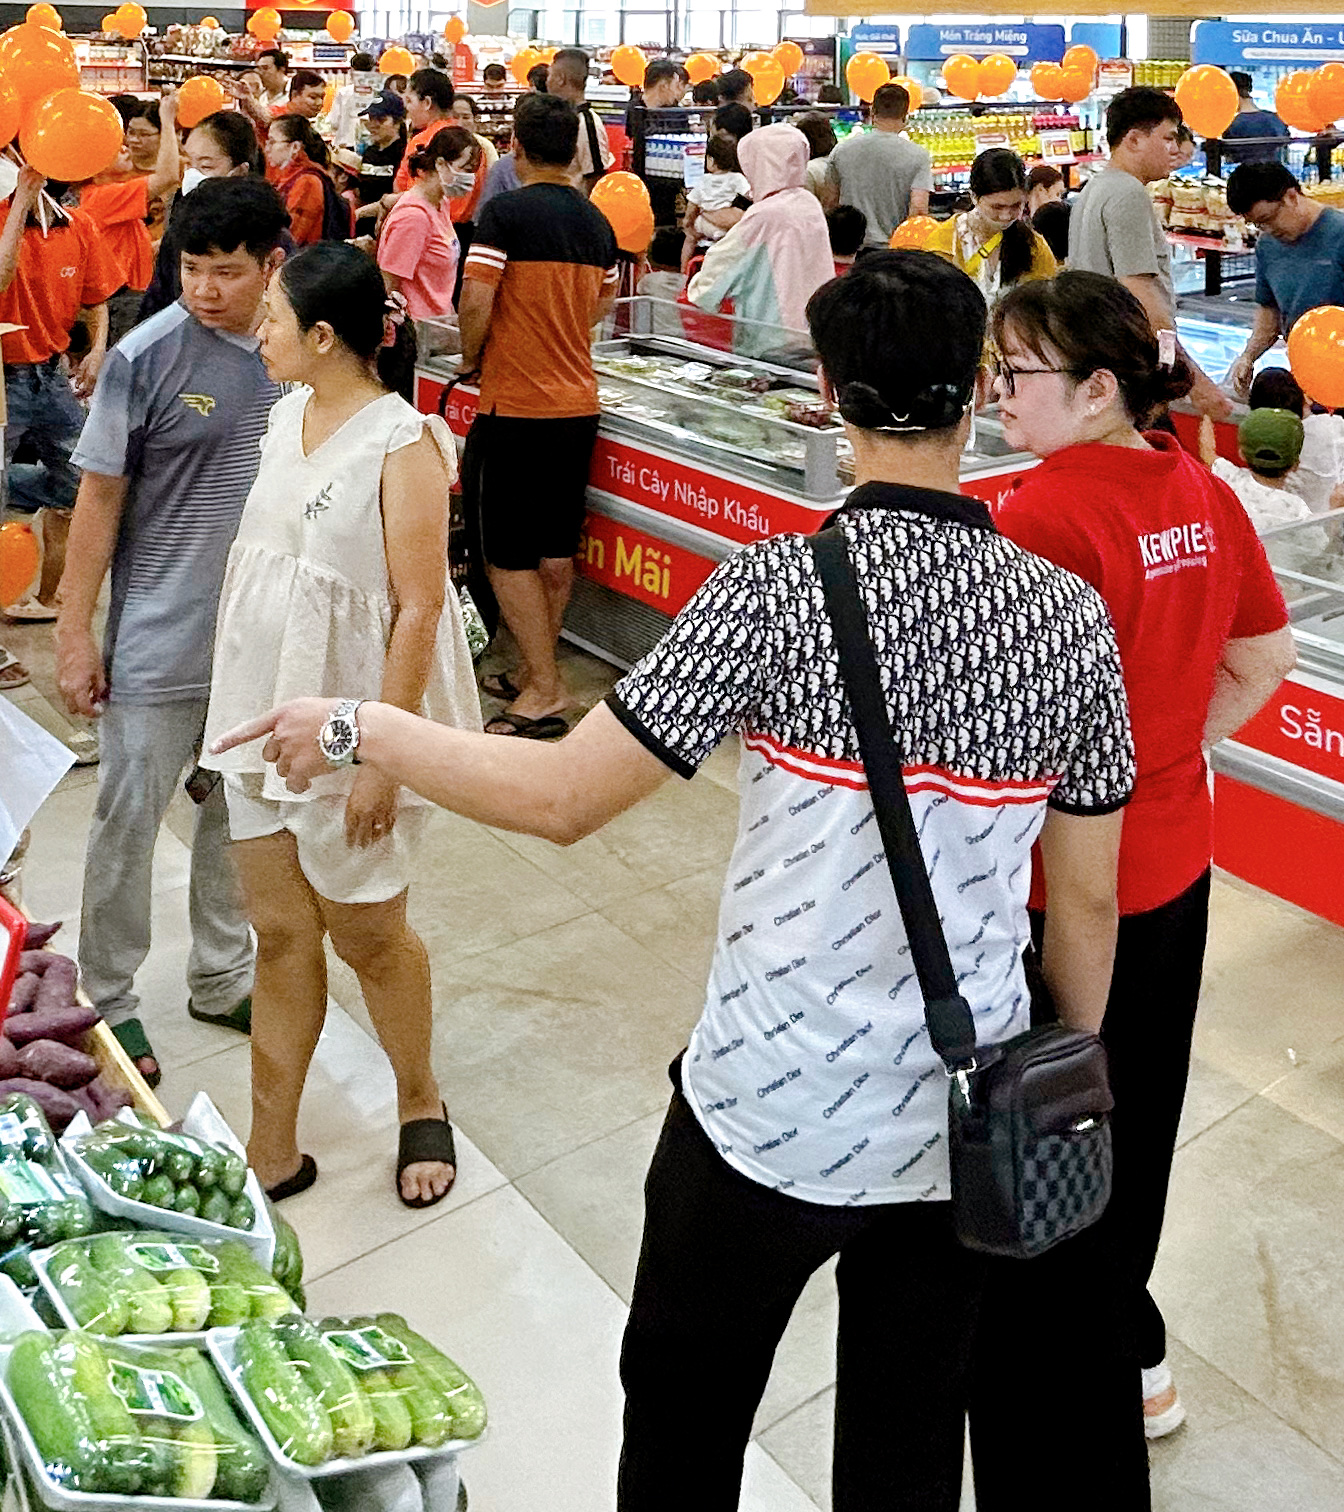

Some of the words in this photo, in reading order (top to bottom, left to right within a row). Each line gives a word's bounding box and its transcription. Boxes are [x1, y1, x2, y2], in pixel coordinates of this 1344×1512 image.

[940, 30, 963, 41] Món
[964, 29, 993, 44] Tráng
[995, 30, 1028, 44] Miệng
[1232, 29, 1258, 44] Sữa
[1262, 29, 1298, 44] Chua
[1302, 27, 1323, 44] Ăn
[607, 455, 635, 485] Trái
[640, 468, 669, 502] Cây
[674, 479, 719, 519] Nhập
[724, 497, 769, 535] Khẩu
[615, 535, 671, 599] Mãi
[1138, 522, 1207, 568] KEWPIE
